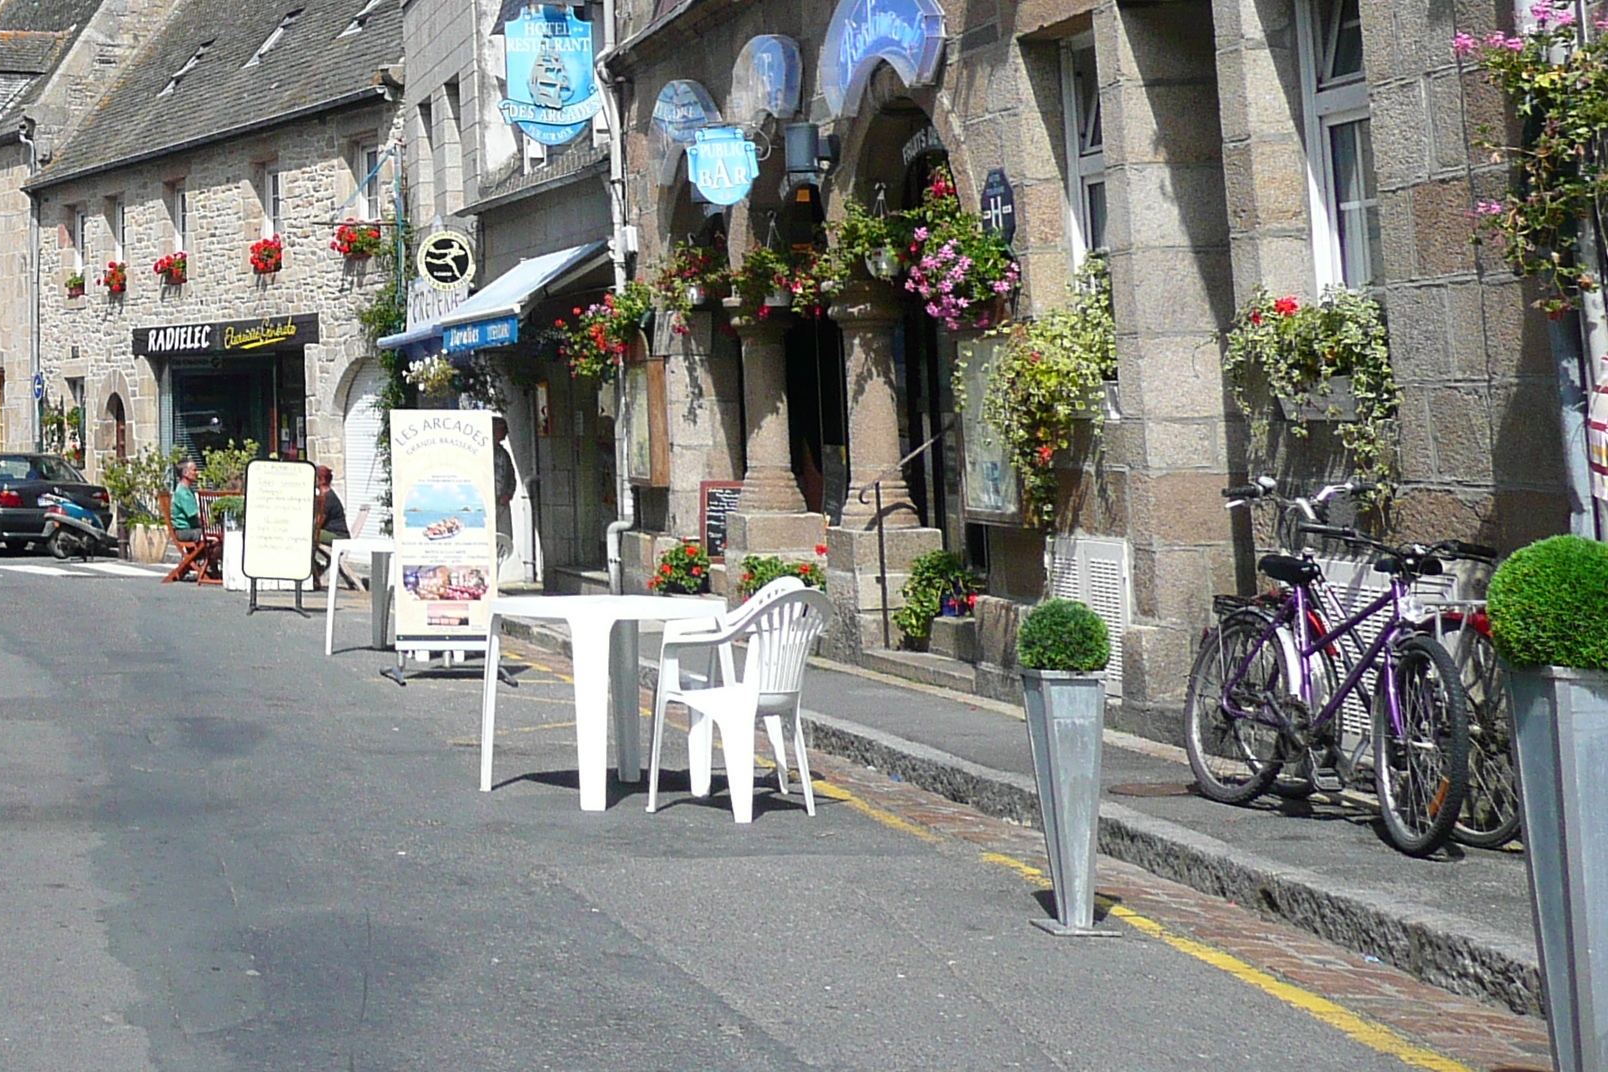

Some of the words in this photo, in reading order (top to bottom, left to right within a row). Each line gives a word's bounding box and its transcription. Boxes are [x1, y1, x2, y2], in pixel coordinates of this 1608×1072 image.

[524, 21, 571, 36] HOTEL
[507, 37, 592, 52] RESTAURANT
[509, 104, 536, 120] DES
[540, 98, 601, 123] ARCADES
[700, 141, 745, 159] PUBLIC
[697, 158, 750, 190] BAR
[148, 324, 212, 352] RADIELEC
[395, 424, 419, 446] LES
[423, 417, 489, 447] ARCADES
